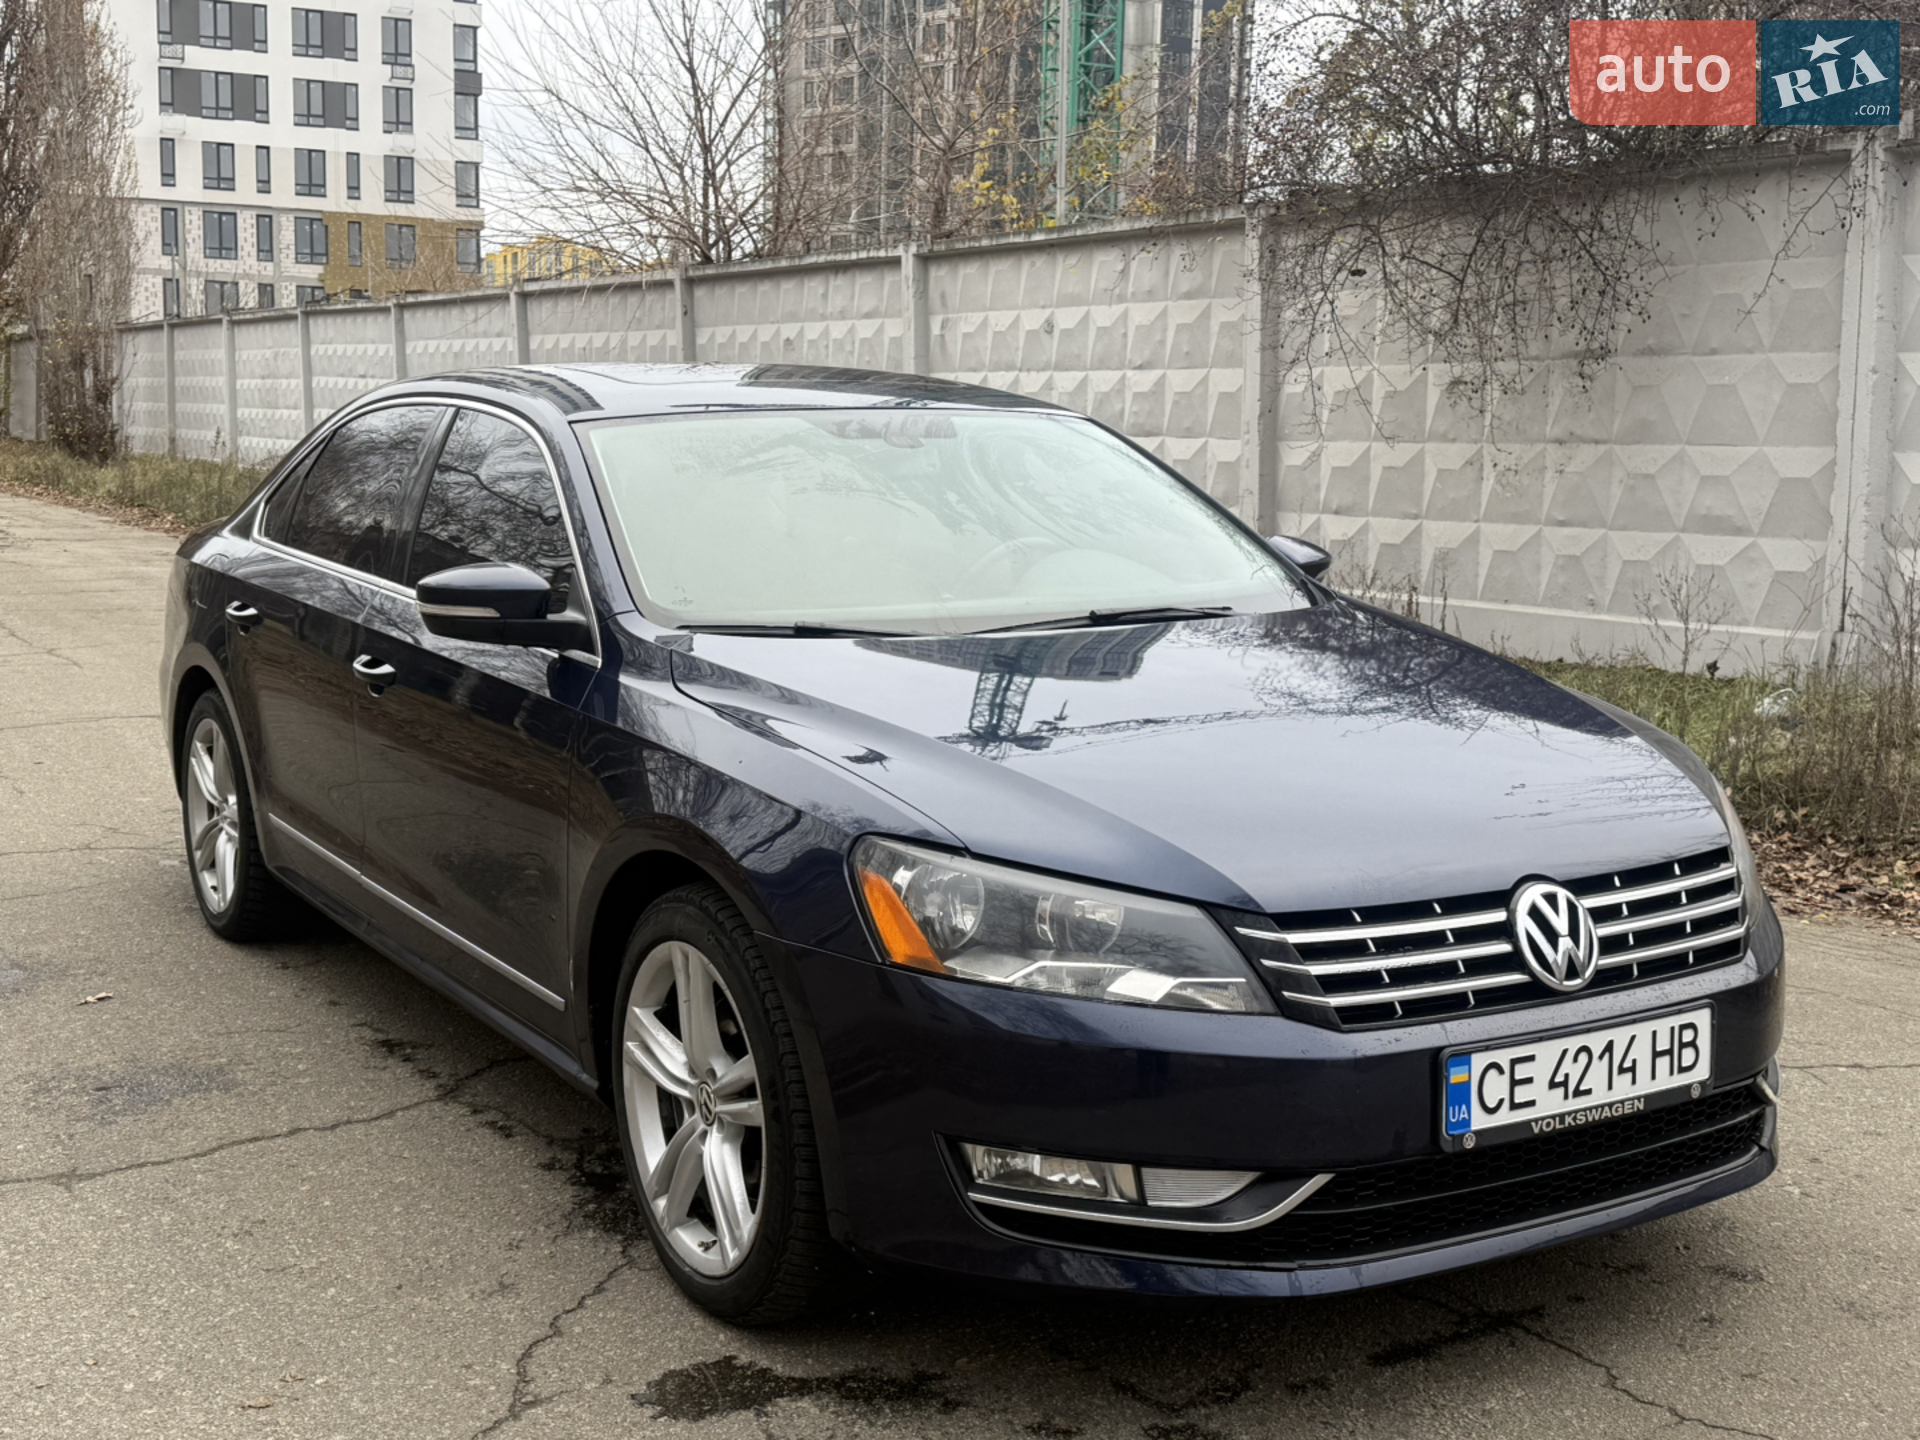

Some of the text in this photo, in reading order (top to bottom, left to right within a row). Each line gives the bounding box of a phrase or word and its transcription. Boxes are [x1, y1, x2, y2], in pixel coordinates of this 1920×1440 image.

[1477, 1021, 1700, 1116] CE 4214 HB
[1449, 1104, 1469, 1122] UA
[1531, 1099, 1644, 1134] VOLKSWAGEN
